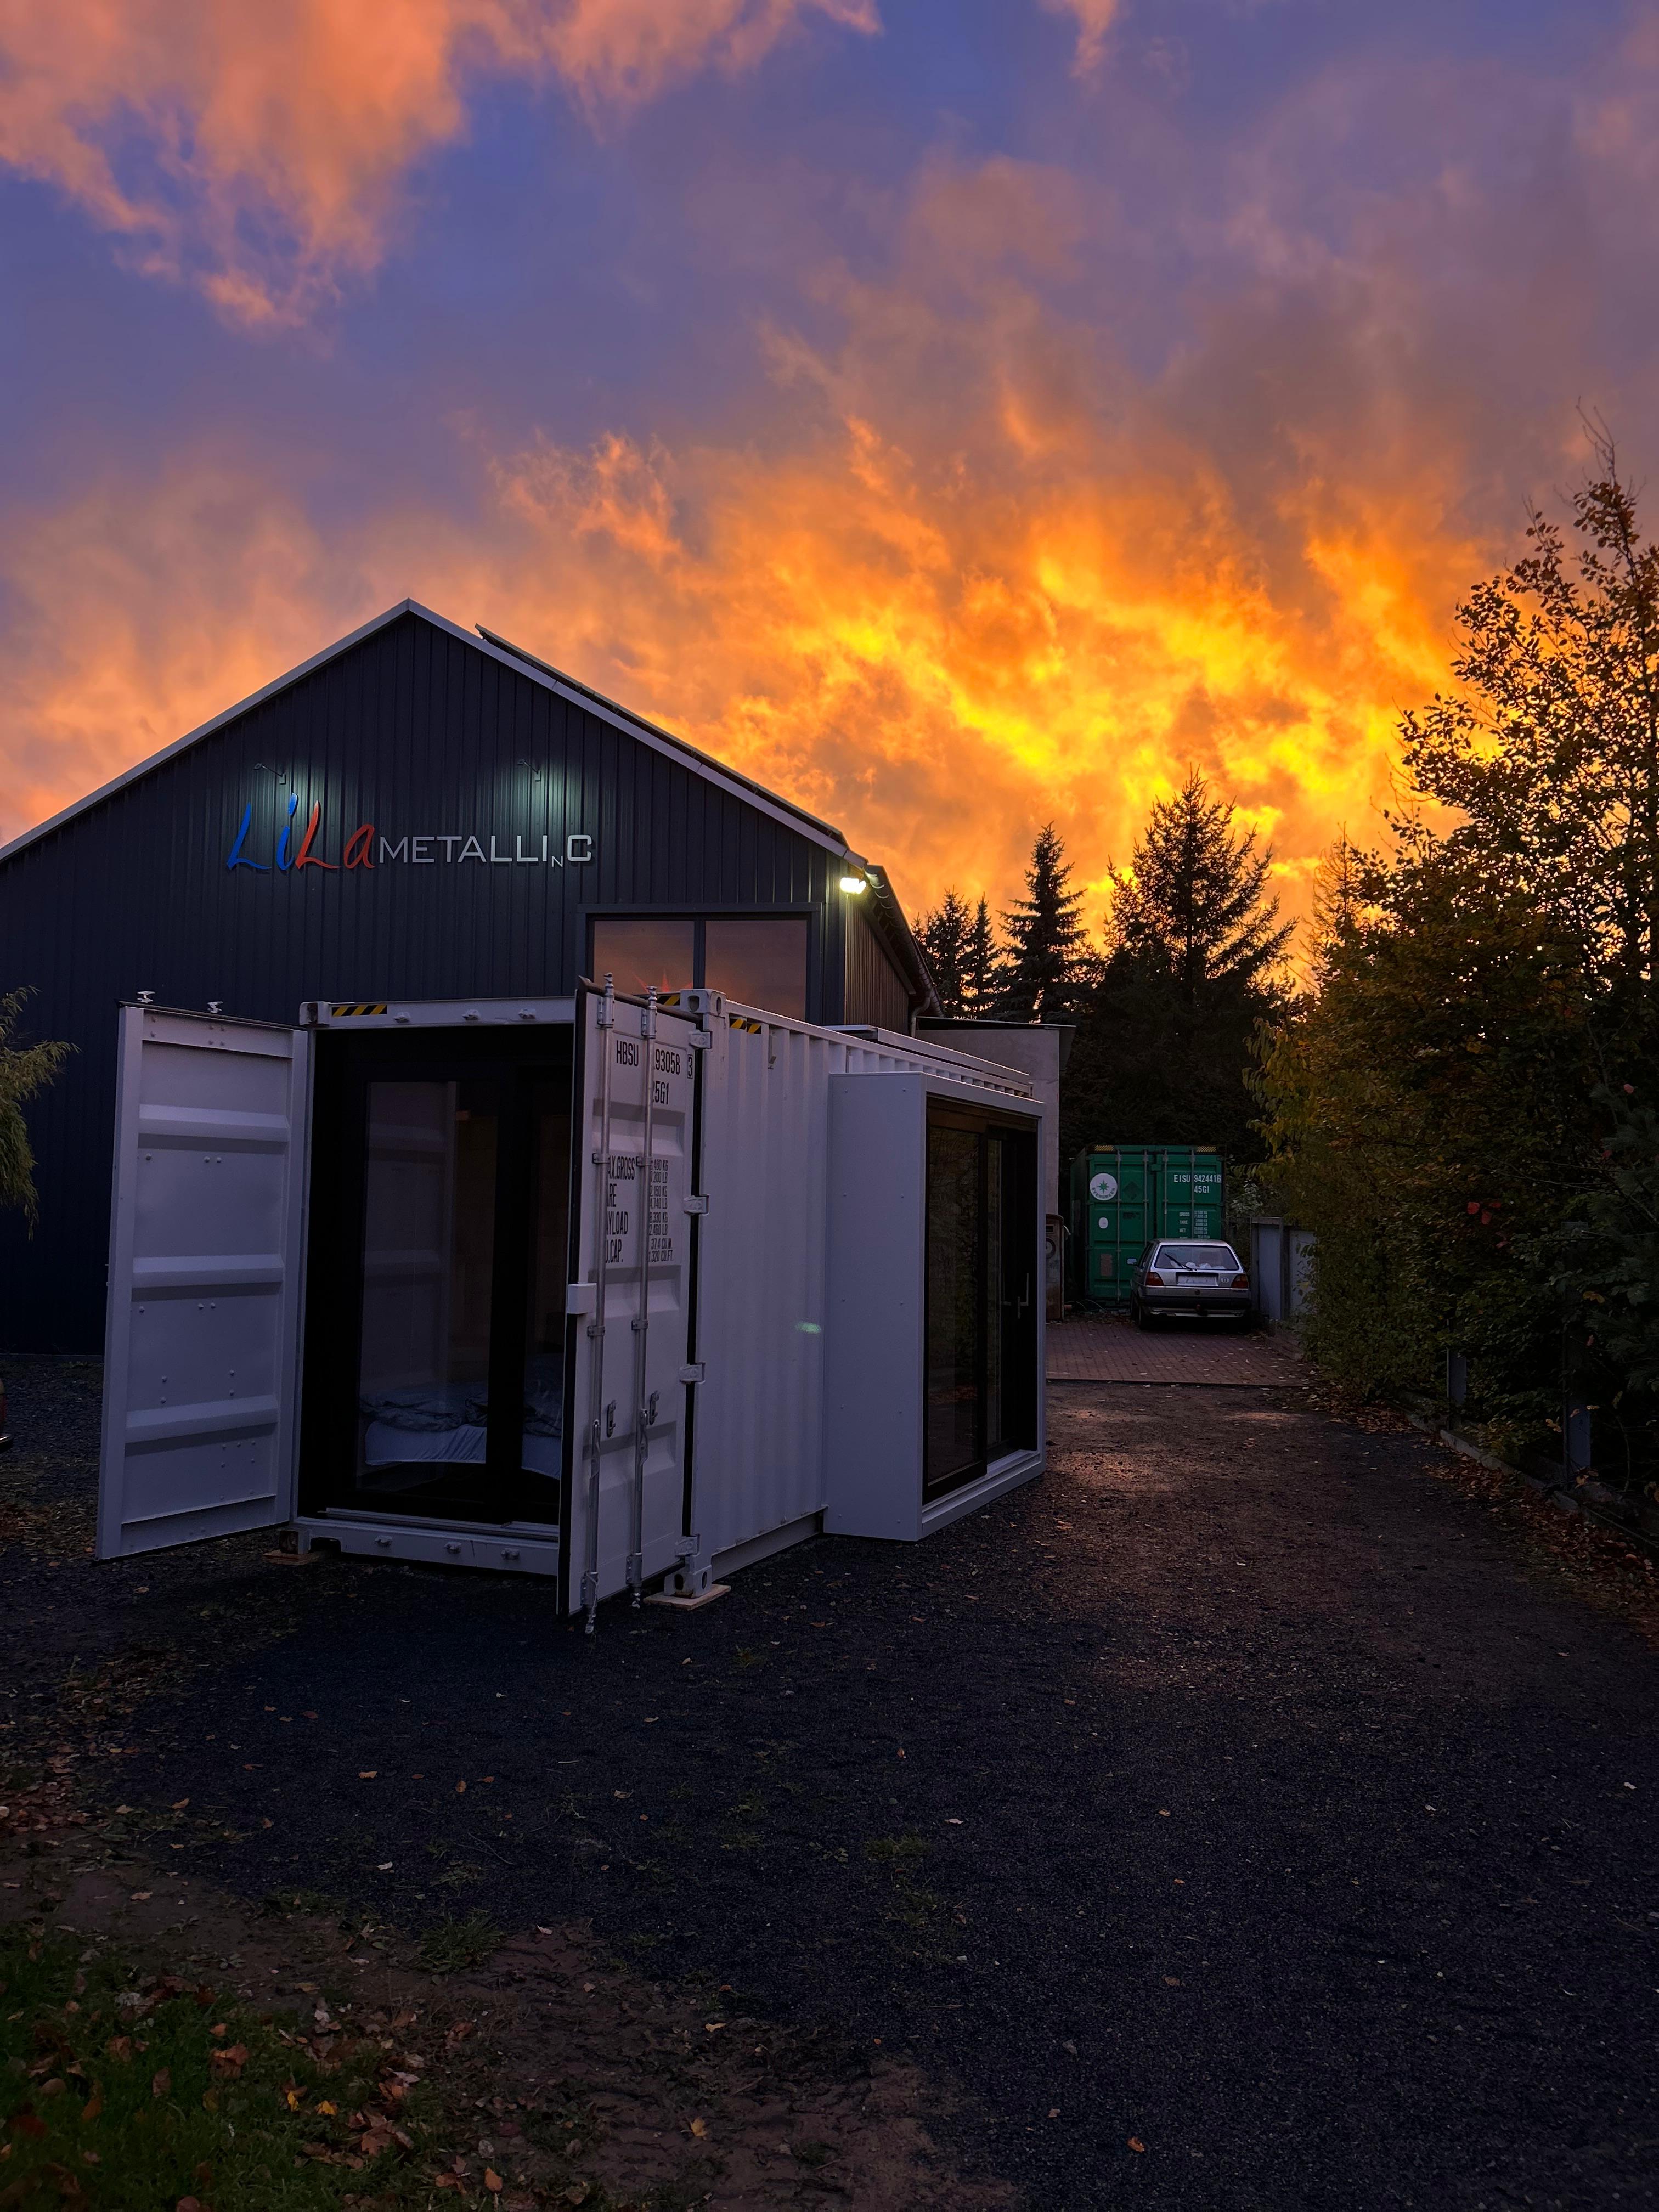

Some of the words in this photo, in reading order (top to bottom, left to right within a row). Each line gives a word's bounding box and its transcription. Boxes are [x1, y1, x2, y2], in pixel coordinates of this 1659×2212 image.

[617, 1040, 639, 1067] HBSU
[654, 1048, 680, 1075] 93058
[653, 1080, 669, 1105] 5G1
[608, 1155, 635, 1180] AX.GROSS
[1174, 1175, 1190, 1183] EISU
[606, 1211, 628, 1234] YLOAD
